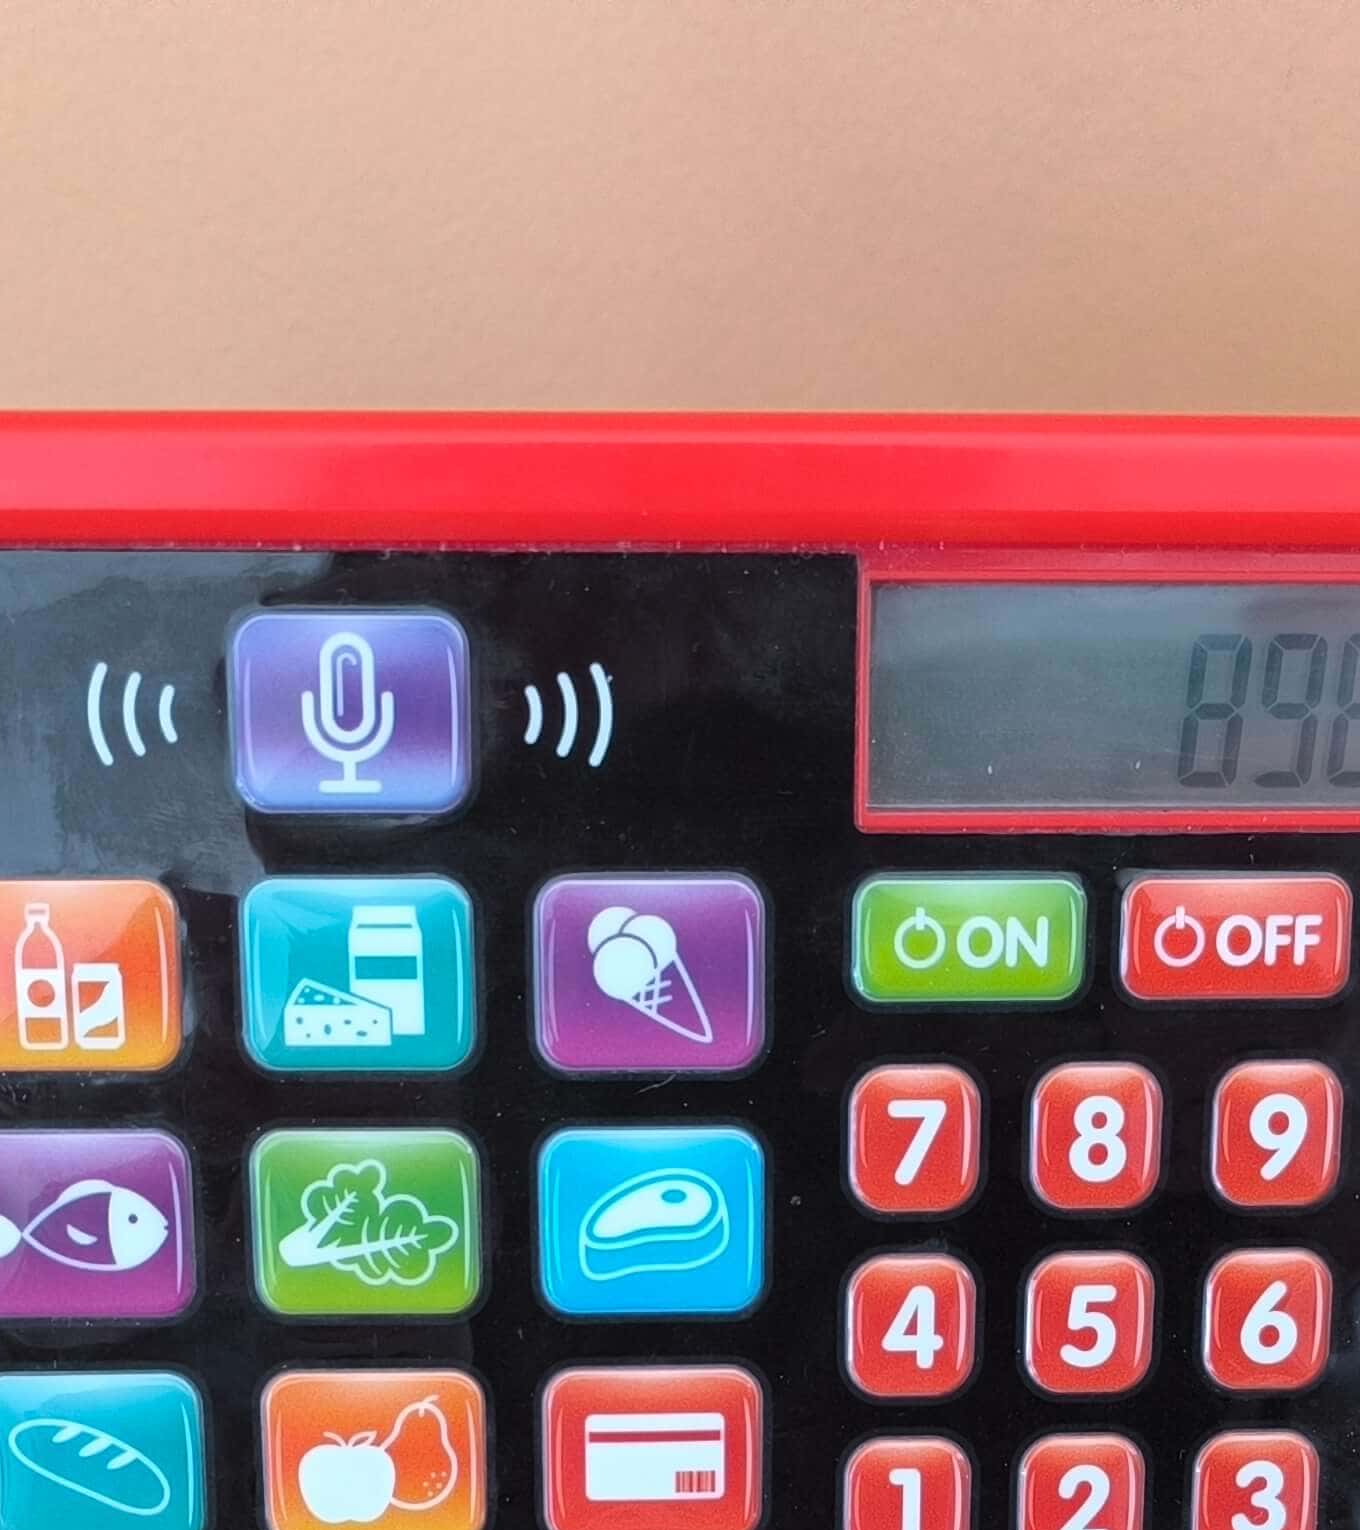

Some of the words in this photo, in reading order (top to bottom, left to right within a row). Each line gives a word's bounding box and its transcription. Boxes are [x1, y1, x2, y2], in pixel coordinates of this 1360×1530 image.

[956, 915, 1050, 969] ON
[1215, 913, 1324, 968] OFF
[886, 1098, 948, 1187] 7
[1068, 1094, 1128, 1183] 8
[1248, 1092, 1308, 1182] 9
[880, 1284, 944, 1370] 4
[1059, 1283, 1117, 1368] 5
[1239, 1280, 1298, 1366] 6
